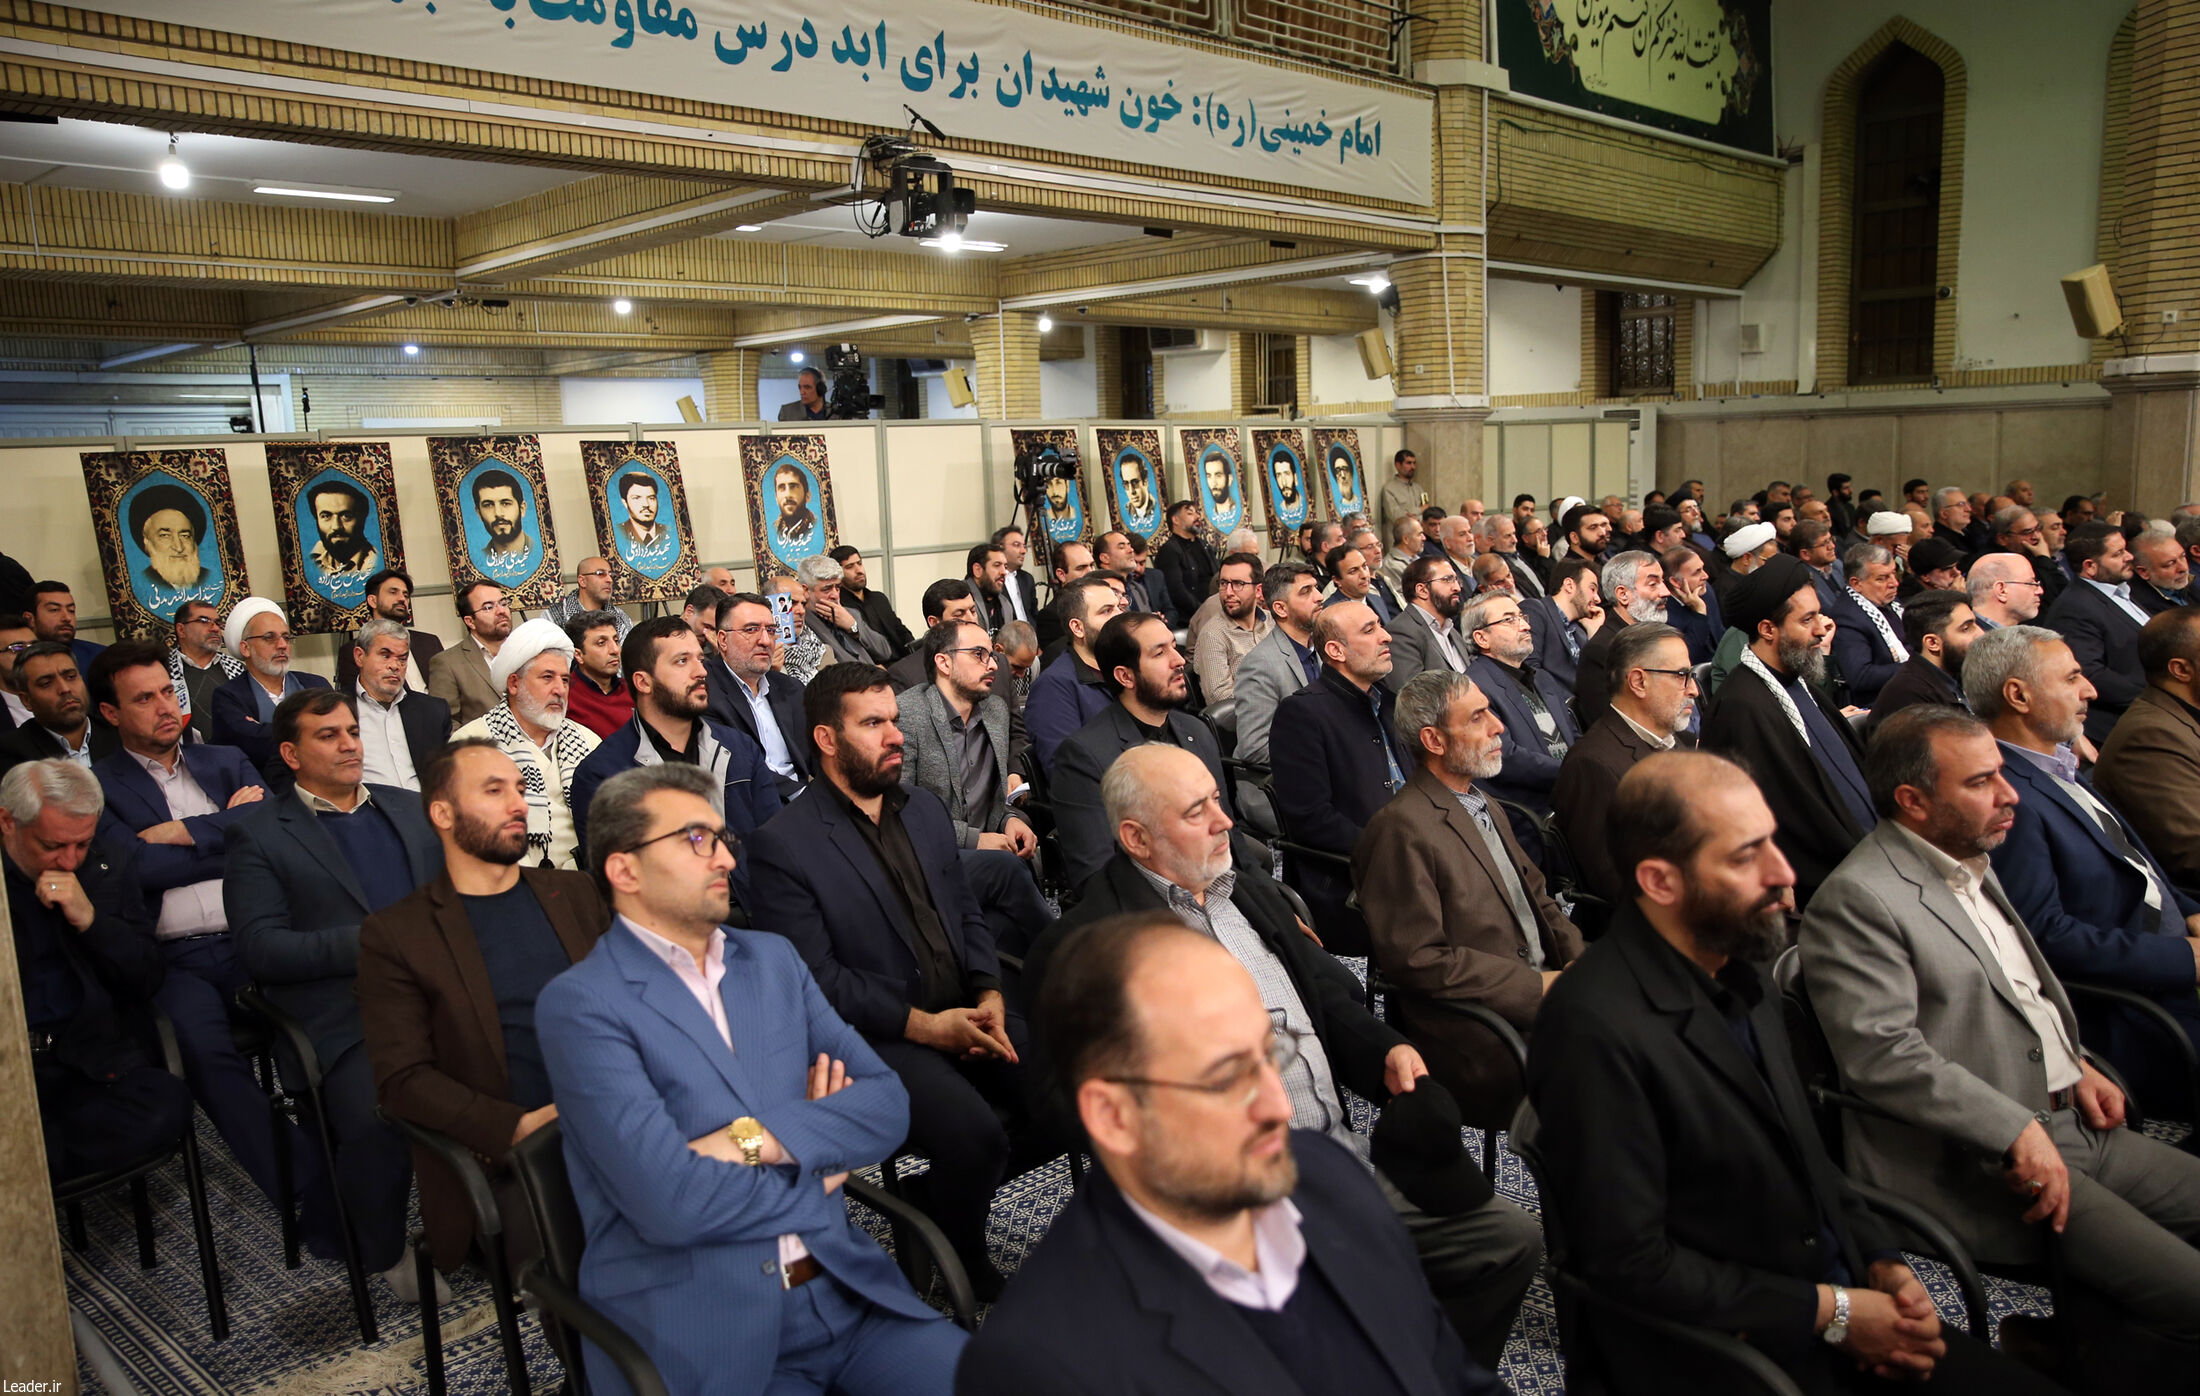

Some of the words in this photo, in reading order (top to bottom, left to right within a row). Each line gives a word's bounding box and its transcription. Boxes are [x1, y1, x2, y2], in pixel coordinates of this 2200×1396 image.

[713, 18, 818, 72] درس
[831, 20, 887, 82] ابد
[899, 30, 980, 99] برای
[996, 50, 1110, 118] شهیدان
[1119, 80, 1183, 134] خون
[1339, 115, 1382, 165] امام
